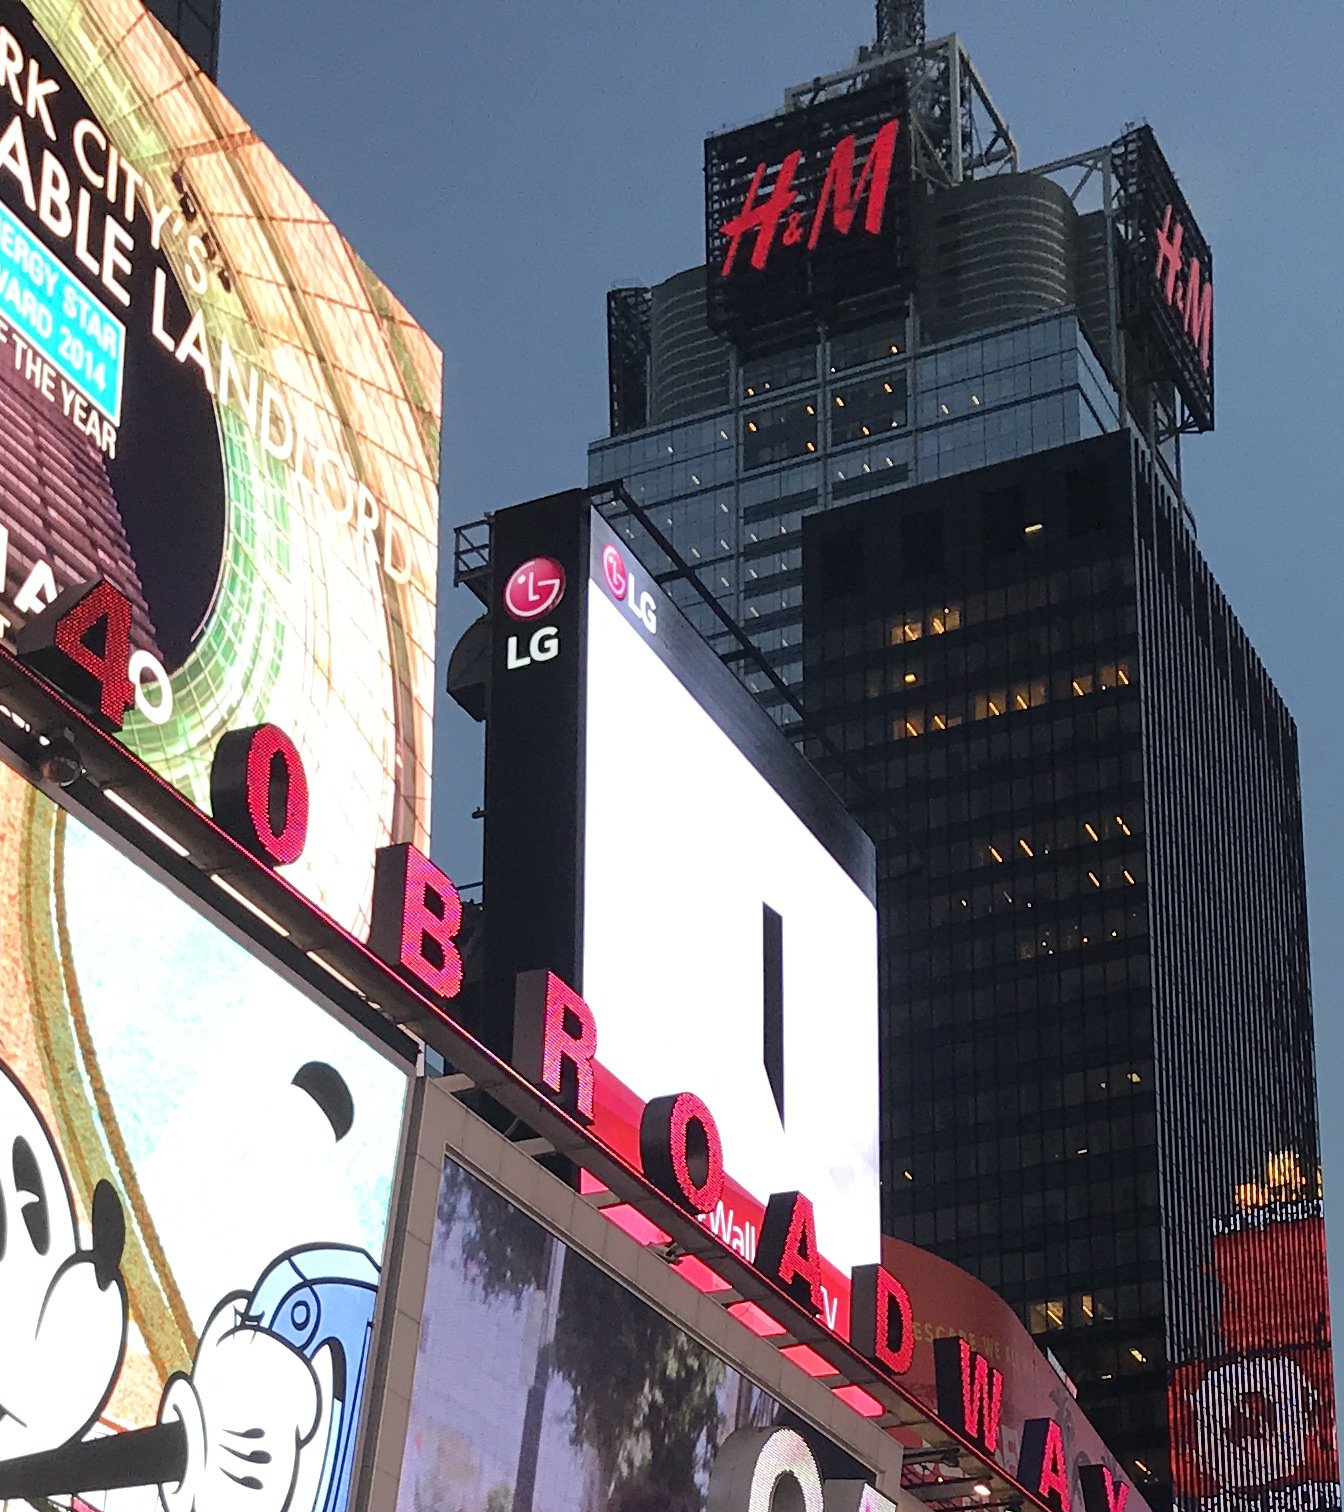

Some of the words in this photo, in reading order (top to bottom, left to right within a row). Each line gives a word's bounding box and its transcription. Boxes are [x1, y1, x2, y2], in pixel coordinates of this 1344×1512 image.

[73, 117, 209, 296] CITY'S
[721, 117, 899, 278] H&M
[63, 285, 119, 360] STAR
[1155, 204, 1214, 376] H&M
[13, 332, 57, 402] THE
[59, 378, 118, 459] YEAR
[57, 327, 107, 389] 2014
[152, 262, 413, 587] LANDLORD
[506, 625, 561, 671] LG
[628, 574, 657, 635] LG
